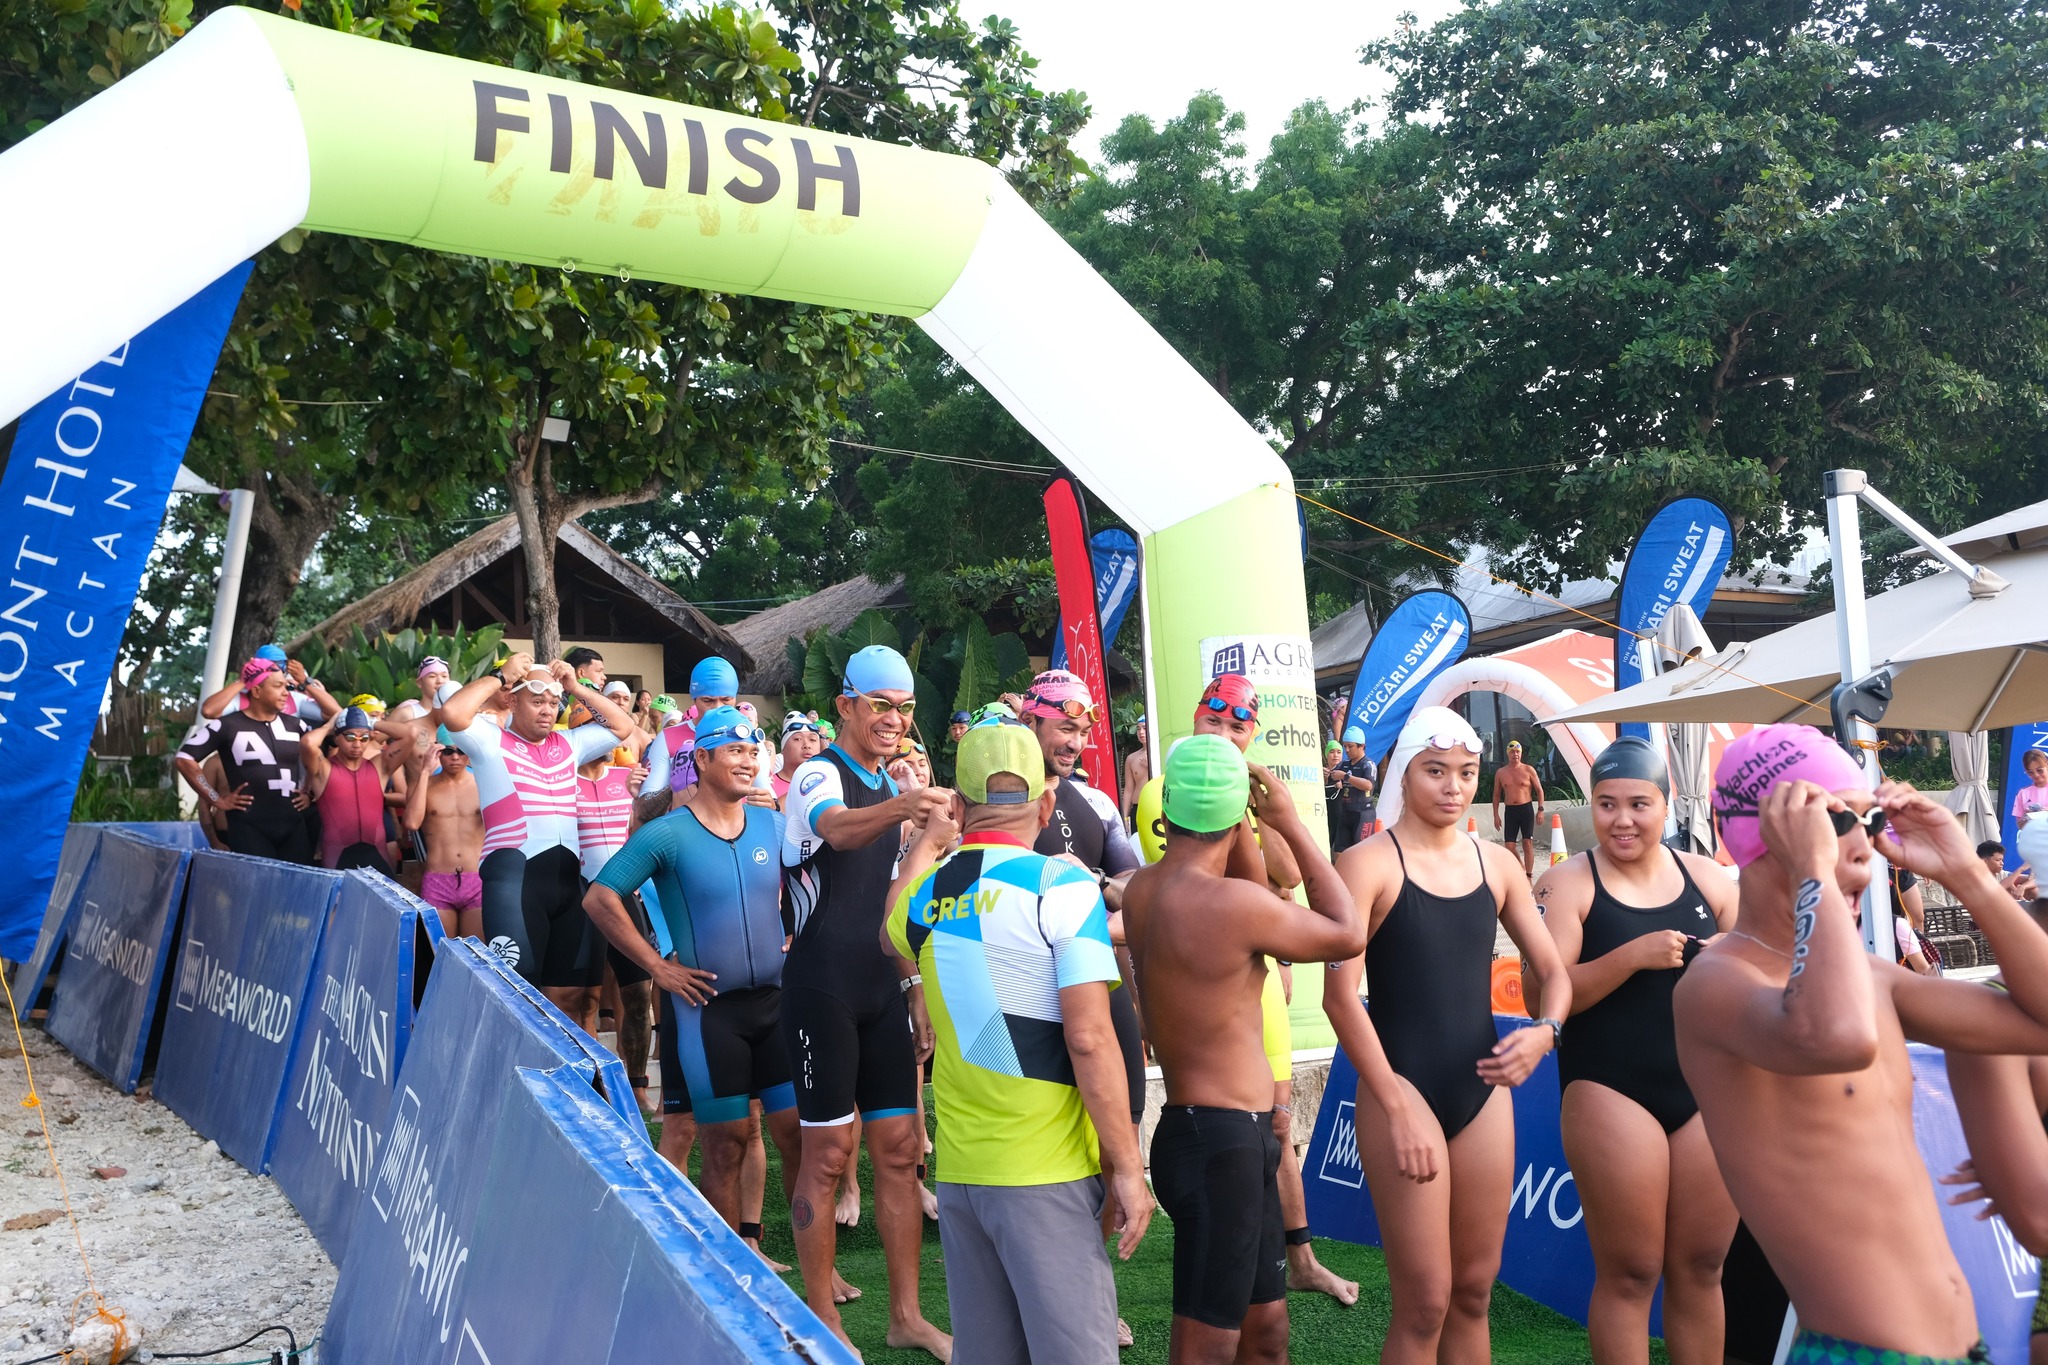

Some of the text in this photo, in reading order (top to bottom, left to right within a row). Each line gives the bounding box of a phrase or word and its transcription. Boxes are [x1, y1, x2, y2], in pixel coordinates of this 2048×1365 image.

[473, 80, 861, 218] FINISH
[1097, 550, 1123, 603] WEAT
[1663, 520, 1705, 592] SWEAT
[0, 534, 58, 748] ONT
[34, 477, 138, 741] MACTAN
[1628, 593, 1673, 670] PARI
[1636, 611, 1648, 630] DRINK
[1358, 612, 1449, 724] POCARI SWEAT
[1361, 690, 1375, 706] SUPPLY
[1374, 675, 1386, 691] DRINK
[1265, 724, 1316, 749] ethos
[922, 888, 1003, 925] CREW
[86, 915, 153, 987] MEGAWORLD
[198, 954, 292, 1044] MEGAWORLD
